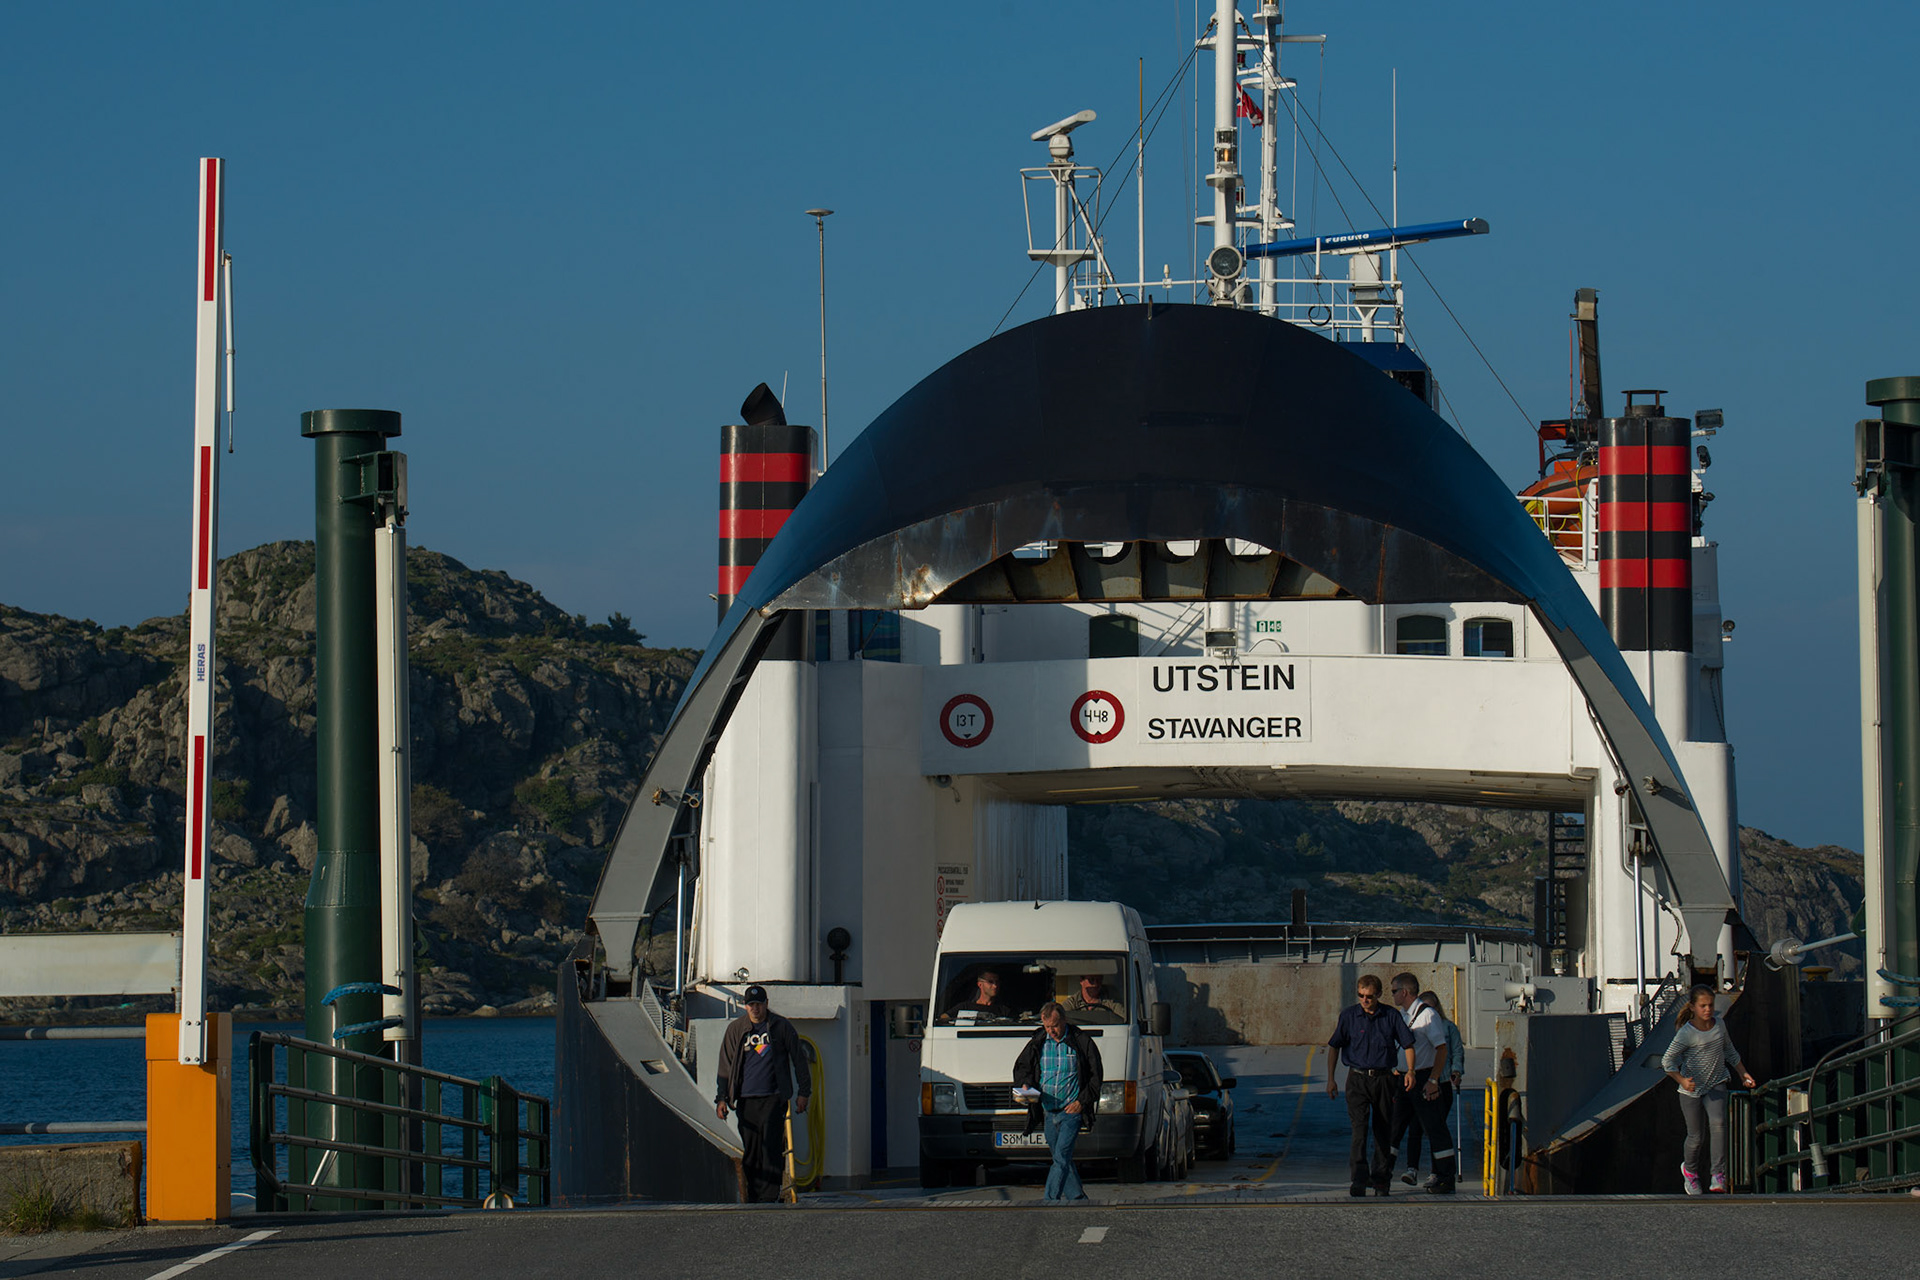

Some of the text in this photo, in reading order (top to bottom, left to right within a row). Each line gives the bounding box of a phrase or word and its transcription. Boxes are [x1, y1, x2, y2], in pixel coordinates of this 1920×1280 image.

[1325, 233, 1369, 244] FURUNO
[197, 643, 206, 682] HERAS
[1153, 665, 1295, 692] UTSTEIN
[1148, 717, 1302, 739] STAVANGER
[1002, 1134, 1023, 1144] SÖM
